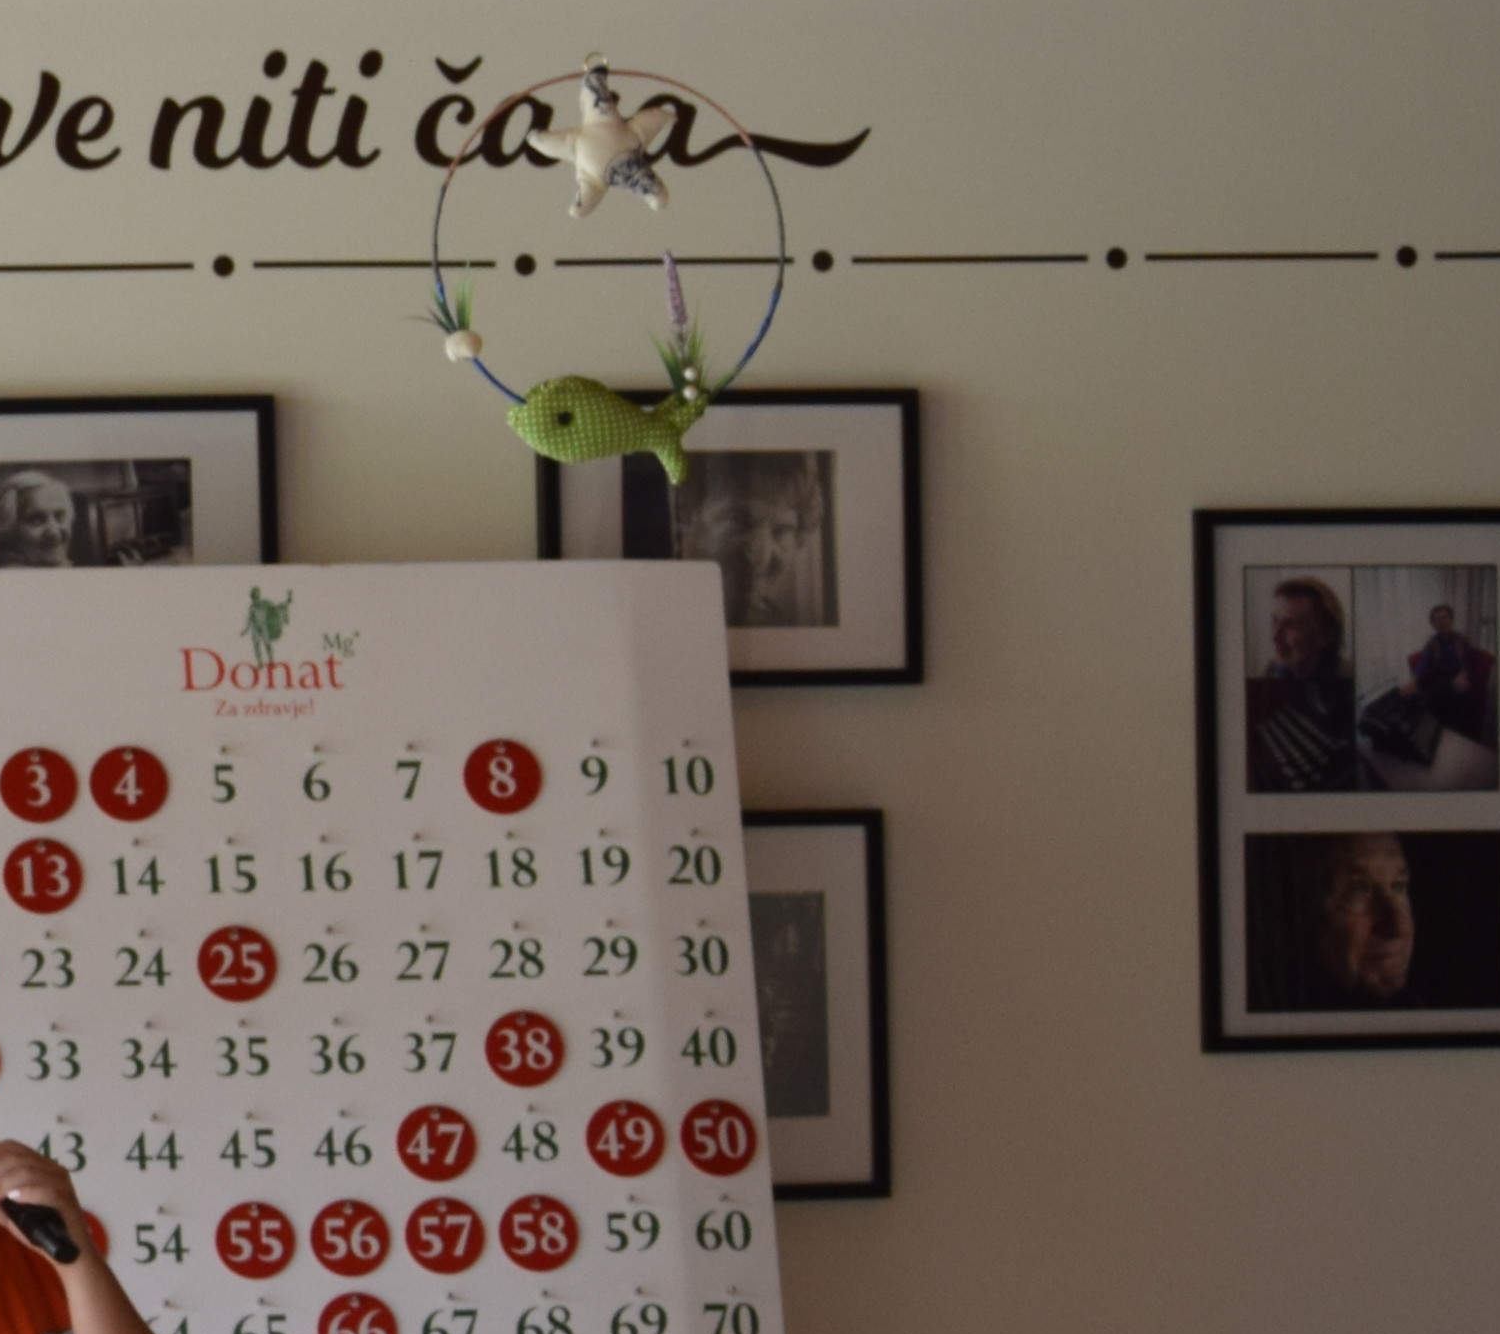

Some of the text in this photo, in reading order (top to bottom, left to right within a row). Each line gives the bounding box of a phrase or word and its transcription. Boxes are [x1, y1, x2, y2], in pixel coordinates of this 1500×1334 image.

[149, 48, 384, 170] niti
[415, 54, 872, 169] čaa
[181, 647, 346, 692] Donat
[215, 699, 238, 717] Za
[27, 764, 51, 806] 3
[113, 765, 143, 805] 4
[213, 763, 236, 804] 5
[301, 764, 331, 802] 6
[395, 760, 422, 800] 7
[488, 756, 516, 797] 8
[579, 756, 609, 794] 9
[663, 756, 714, 795] 10
[18, 855, 70, 897] 13
[113, 856, 165, 896] 14
[207, 854, 257, 894] 15
[300, 853, 353, 892] 16
[393, 850, 443, 890] 17
[486, 847, 538, 888] 18
[578, 845, 631, 886] 19
[670, 845, 722, 885] 20
[20, 947, 75, 989] 23
[114, 946, 171, 987] 24
[209, 942, 265, 985] 25
[302, 943, 360, 983] 26
[395, 940, 450, 981] 27
[489, 938, 545, 979] 28
[582, 936, 638, 977] 29
[679, 935, 729, 976] 30
[30, 1039, 81, 1081] 33
[124, 1038, 177, 1079] 34
[219, 1036, 270, 1077] 35
[312, 1034, 366, 1075] 36
[406, 1032, 457, 1073] 37
[499, 1028, 553, 1071] 38
[594, 1027, 646, 1069] 39
[680, 1027, 737, 1067] 40
[124, 1130, 184, 1171] 44
[218, 1128, 277, 1169] 45
[312, 1126, 373, 1167] 46
[405, 1123, 465, 1165] 47
[501, 1121, 559, 1163] 48
[595, 1117, 654, 1160] 49
[693, 1116, 748, 1160] 50
[134, 1210, 752, 1265] 54 55 56 57 58 59 60
